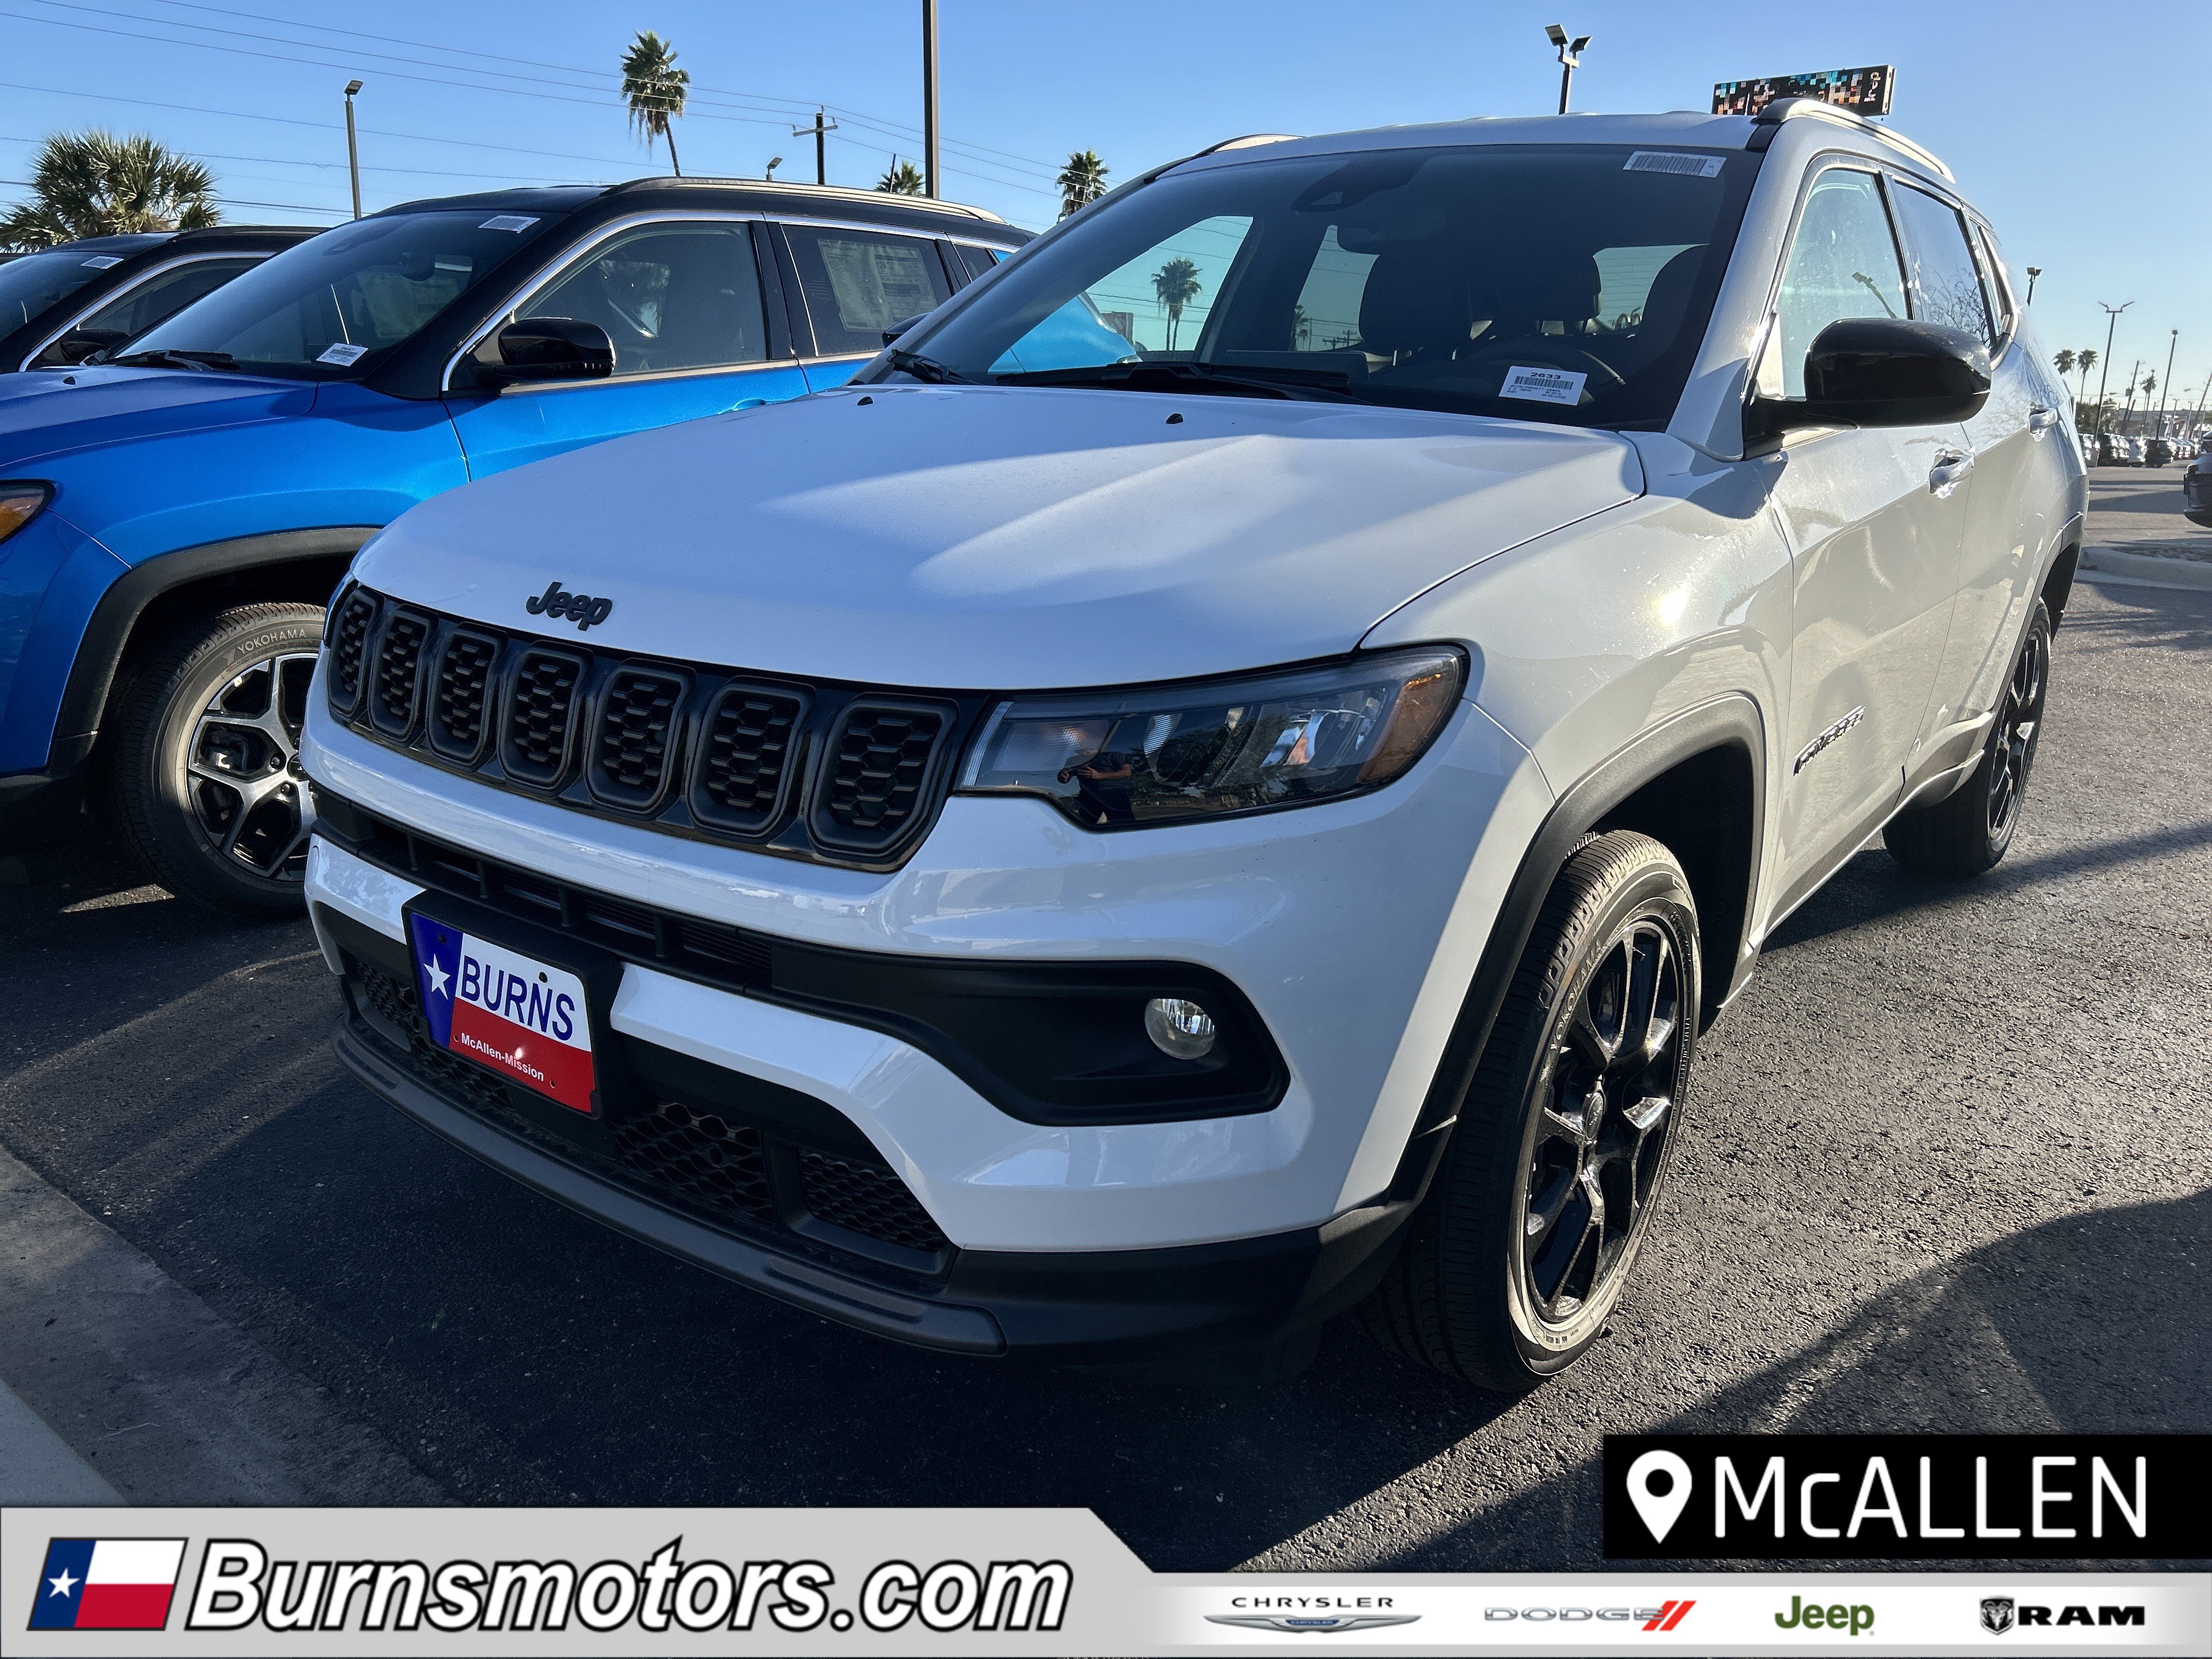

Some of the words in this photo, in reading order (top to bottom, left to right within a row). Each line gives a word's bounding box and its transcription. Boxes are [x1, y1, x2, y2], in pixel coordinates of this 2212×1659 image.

[526, 581, 613, 631] Jeep
[237, 628, 308, 654] YOKOHAMA
[461, 955, 575, 1041] BURNS
[461, 1032, 544, 1082] McAllen-Mission
